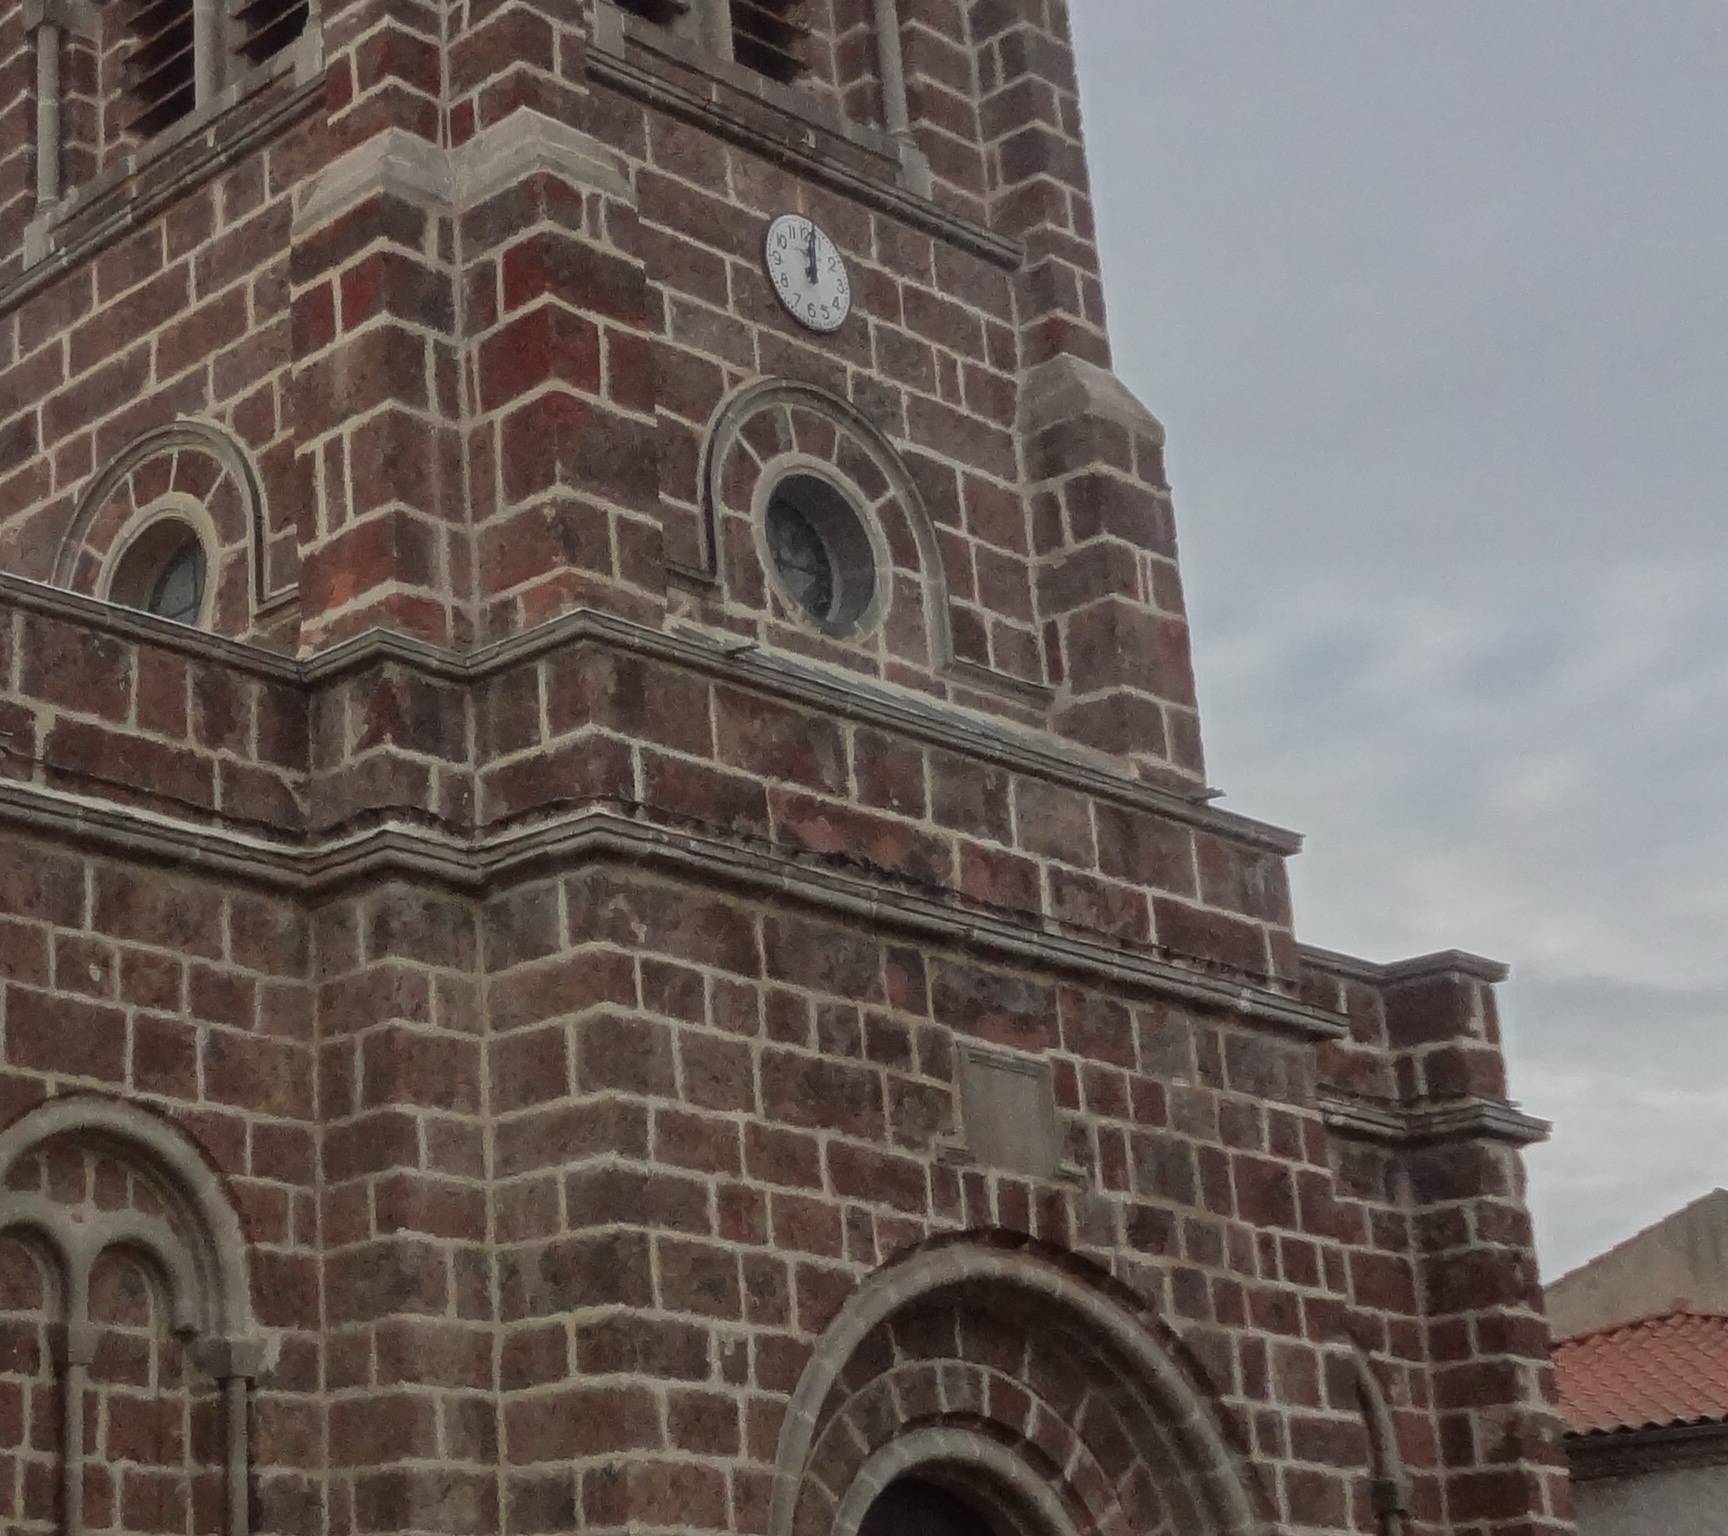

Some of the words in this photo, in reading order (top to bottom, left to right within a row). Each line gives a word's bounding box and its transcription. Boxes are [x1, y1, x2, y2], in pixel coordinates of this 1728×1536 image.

[776, 231, 787, 250] 10
[772, 250, 782, 266] 9
[828, 256, 837, 272] 2
[781, 271, 789, 288] 8
[836, 278, 845, 294] 3
[792, 291, 802, 306] 7
[832, 295, 841, 310] 4
[807, 302, 817, 318] 6
[820, 304, 830, 320] 5
